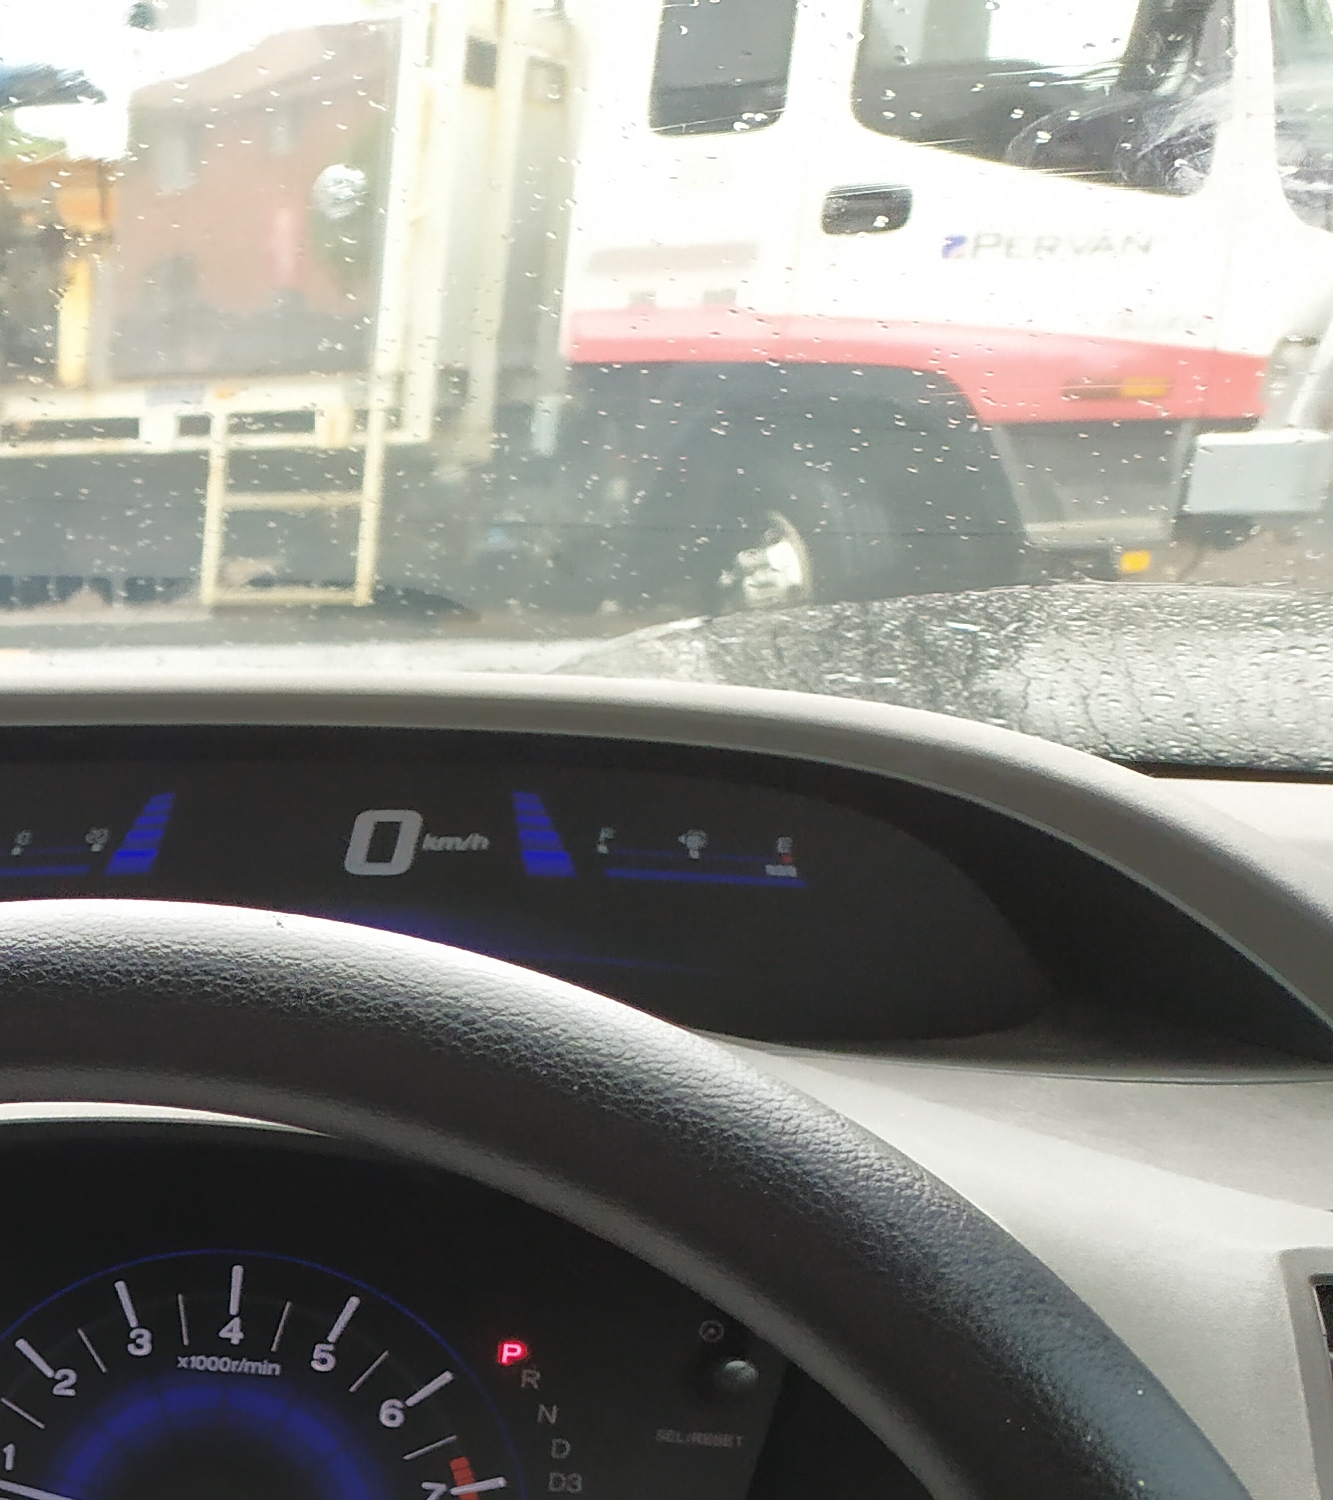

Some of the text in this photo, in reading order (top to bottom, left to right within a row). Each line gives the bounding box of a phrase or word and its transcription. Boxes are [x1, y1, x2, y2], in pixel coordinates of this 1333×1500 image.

[344, 809, 490, 876] 0 km/h
[127, 1328, 153, 1356] 3
[219, 1317, 244, 1345] 4
[311, 1343, 336, 1372] 5
[500, 1342, 525, 1364] P
[52, 1368, 77, 1397] 2
[521, 1369, 541, 1389] R
[379, 1399, 405, 1428] 6
[537, 1404, 557, 1424] N
[3, 1443, 15, 1471] 1
[550, 1438, 571, 1459] D
